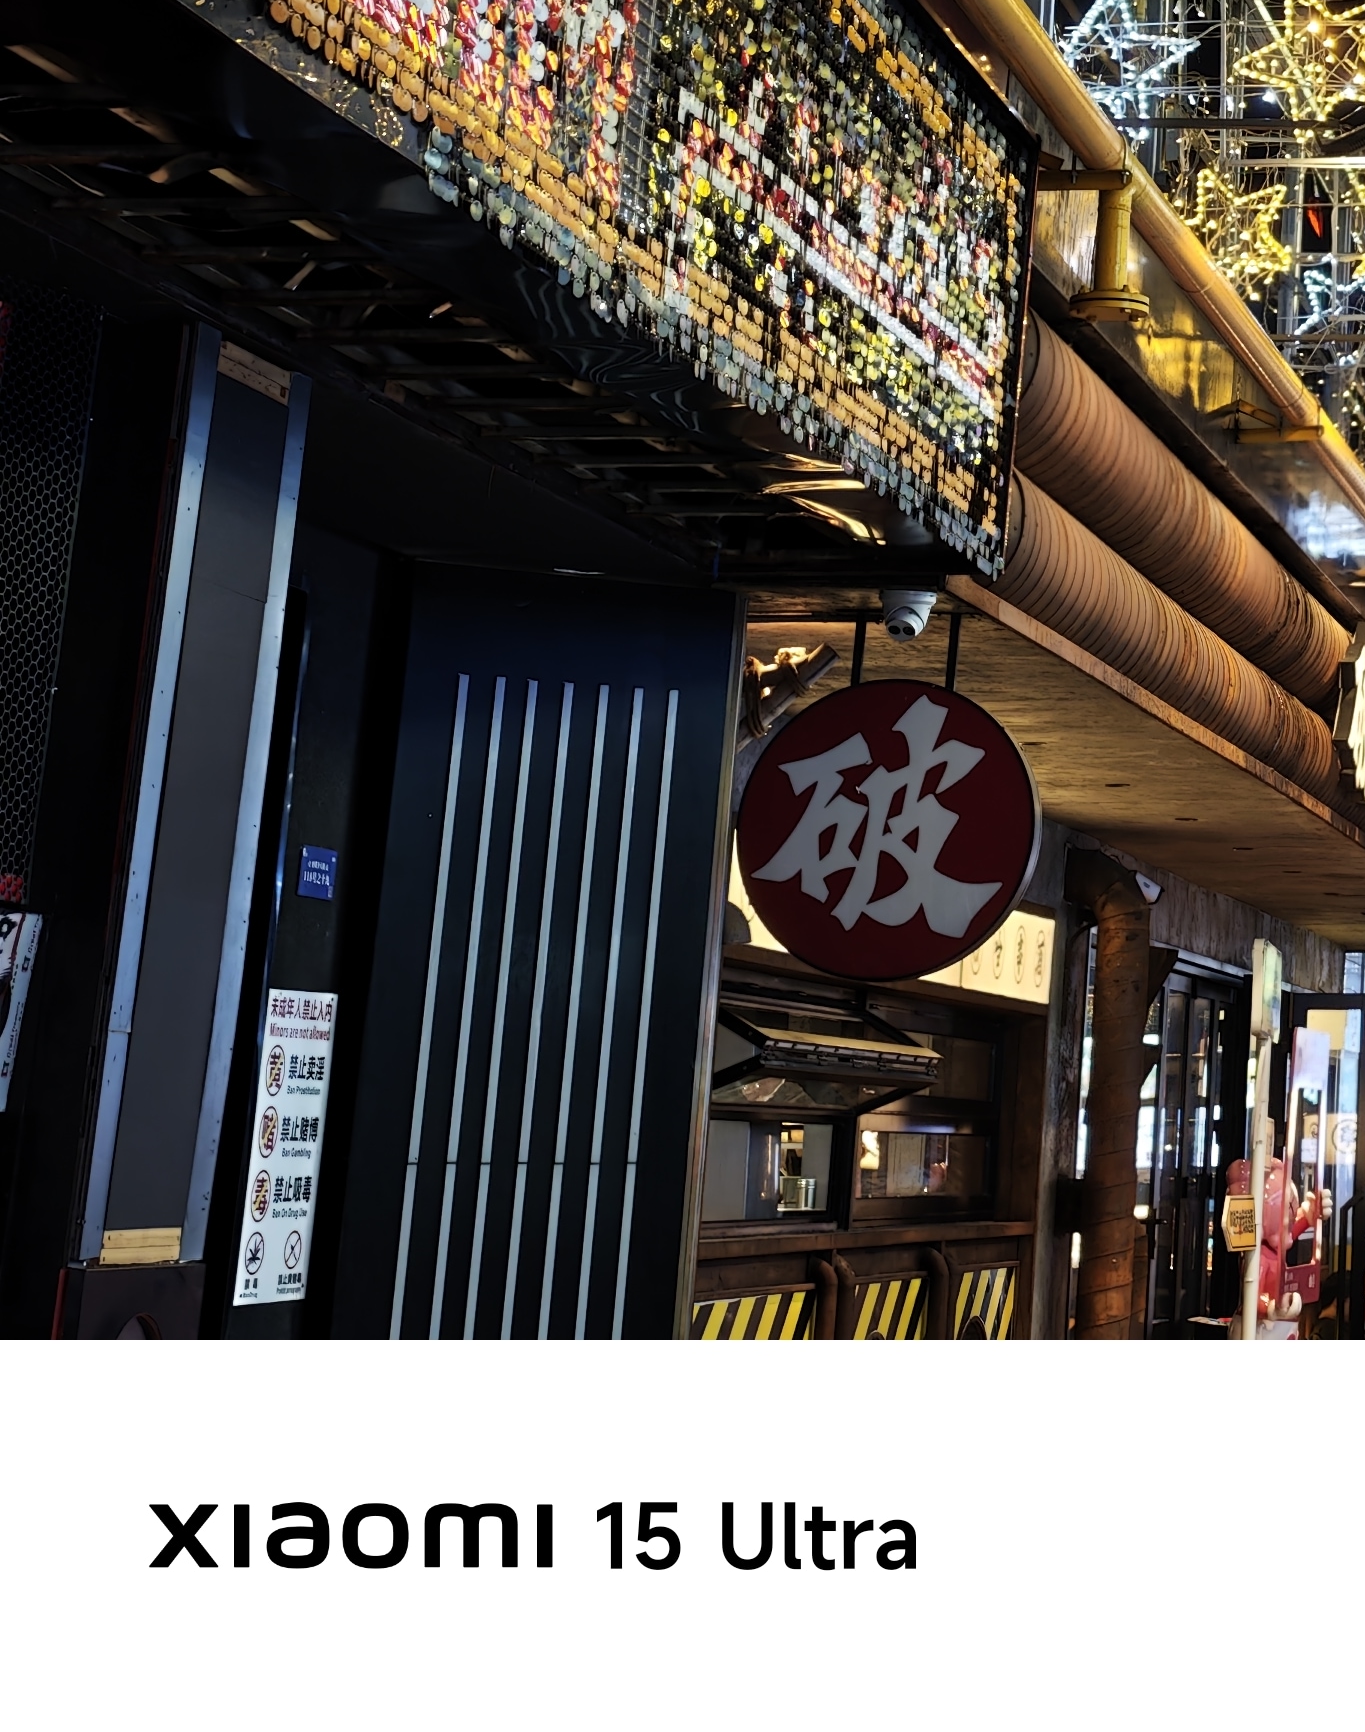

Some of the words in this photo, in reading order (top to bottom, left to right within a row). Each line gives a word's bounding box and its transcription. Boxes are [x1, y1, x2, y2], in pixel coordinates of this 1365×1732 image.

[751, 694, 1002, 938] 破
[271, 997, 333, 1023] 未成年人禁止入内
[269, 1023, 289, 1039] Minors
[290, 1027, 298, 1039] are
[299, 1026, 309, 1040] not
[309, 1026, 331, 1042] allowed
[288, 1054, 326, 1081] 禁止卖淫
[287, 1087, 295, 1095] Ban
[280, 1115, 320, 1143] 禁止赌博
[273, 1175, 313, 1203] 禁止吸毒
